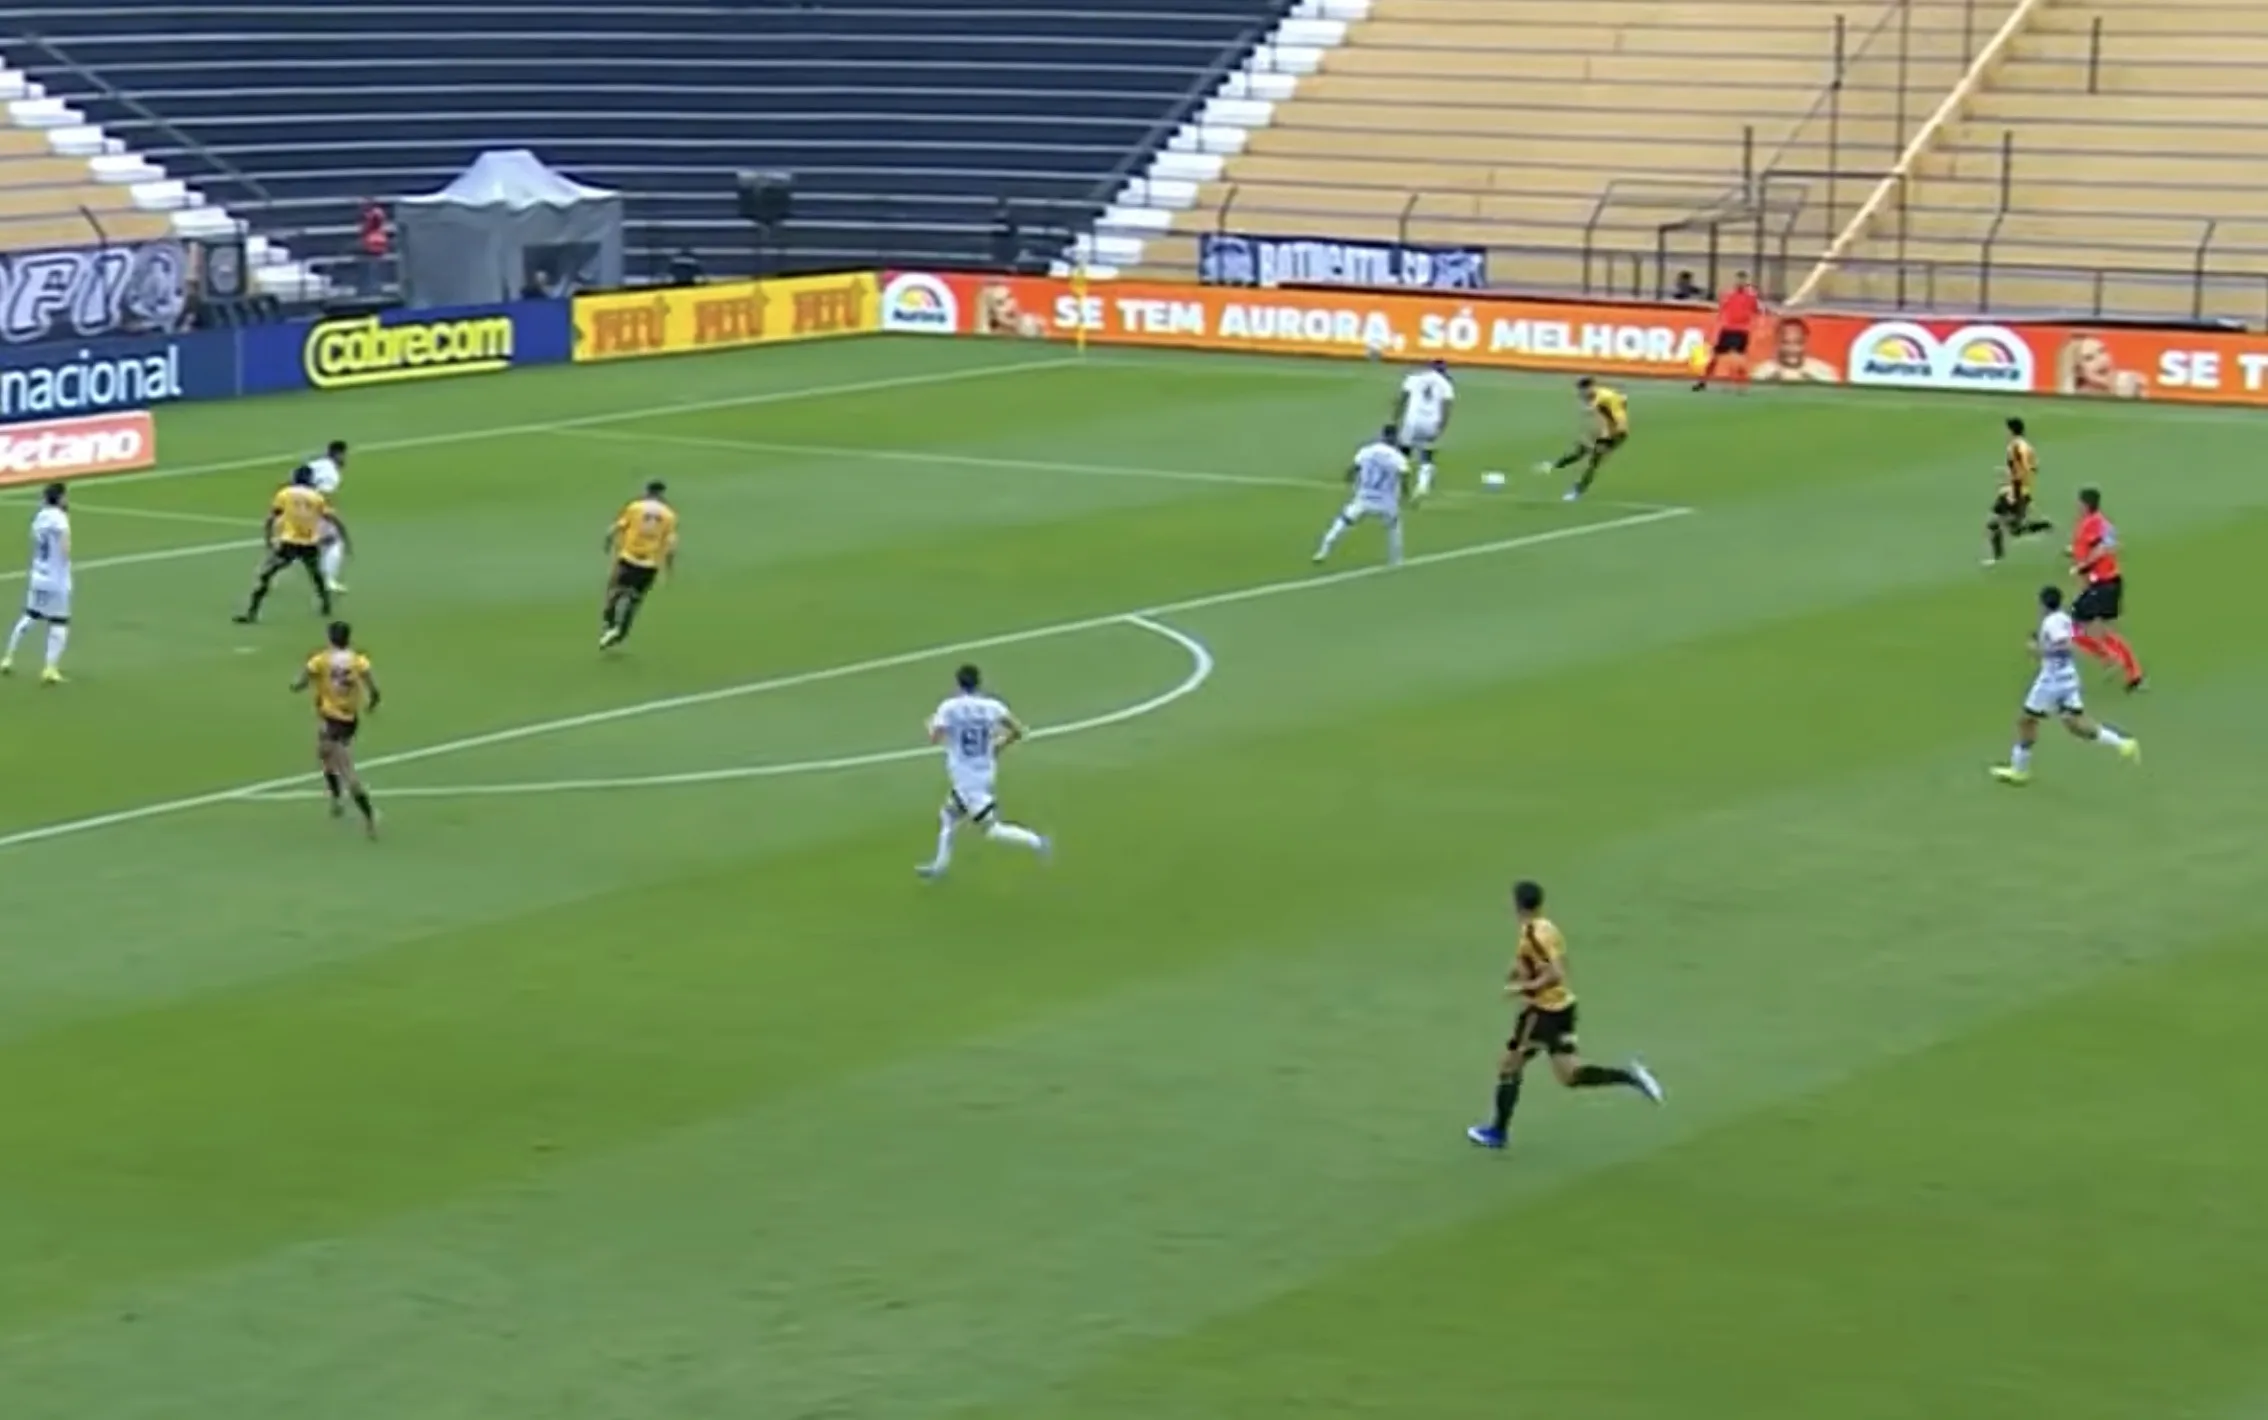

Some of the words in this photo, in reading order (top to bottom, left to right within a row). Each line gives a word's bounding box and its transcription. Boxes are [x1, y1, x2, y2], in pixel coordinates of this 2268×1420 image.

[319, 315, 514, 374] cobrecom
[1054, 296, 1105, 330] SE
[1116, 298, 1205, 335] TEM
[1218, 303, 1406, 351] AURORA,
[1418, 308, 1480, 350] SÓ
[1489, 319, 1705, 363] MELHORA
[0, 344, 182, 414] nacional
[1863, 360, 1932, 379] Aurora
[1951, 364, 2021, 382] Aurora
[2158, 349, 2220, 389] SE
